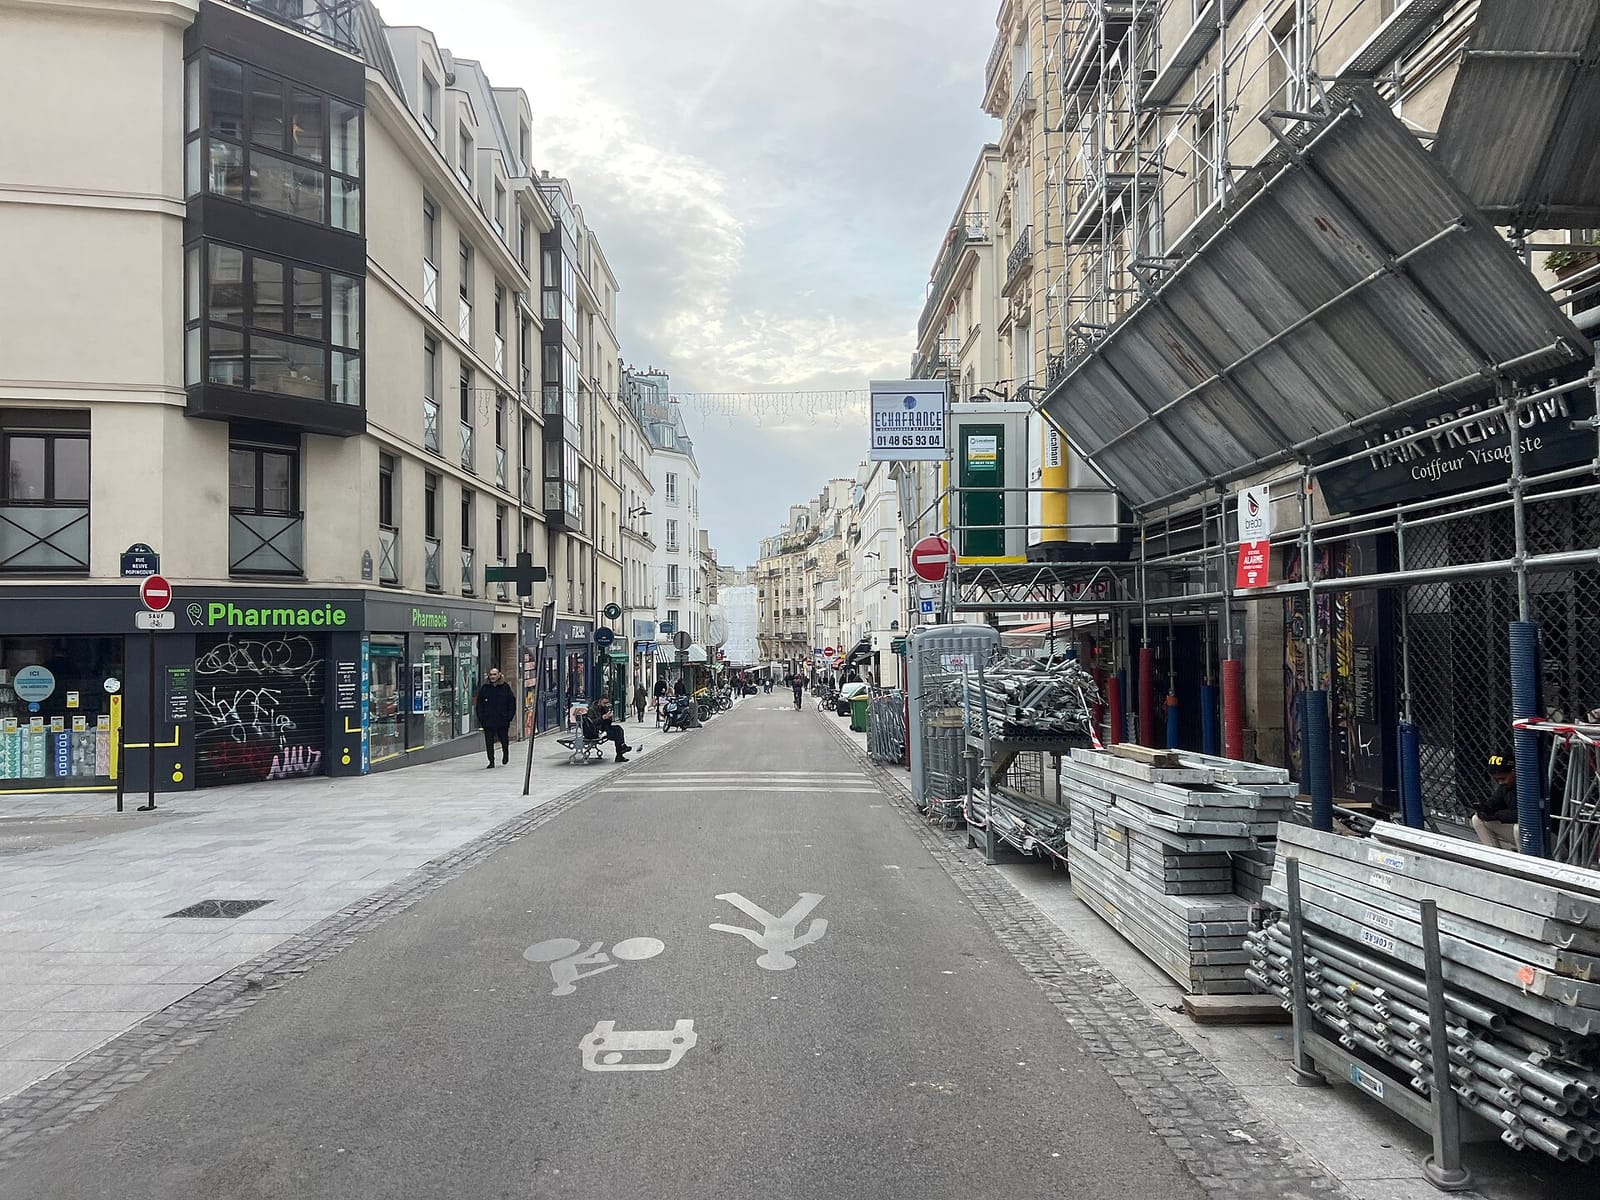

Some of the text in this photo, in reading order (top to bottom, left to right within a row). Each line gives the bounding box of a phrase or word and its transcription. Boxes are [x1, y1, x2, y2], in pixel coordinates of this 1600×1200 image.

[875, 411, 942, 427] ECHAFRANCE
[877, 435, 940, 446] 01 48 65 93 04
[1363, 426, 1426, 471] HAIR
[1411, 436, 1544, 482] Coiffeur Visagste
[207, 602, 346, 627] Pharmacie
[412, 607, 447, 628] Pharmacie
